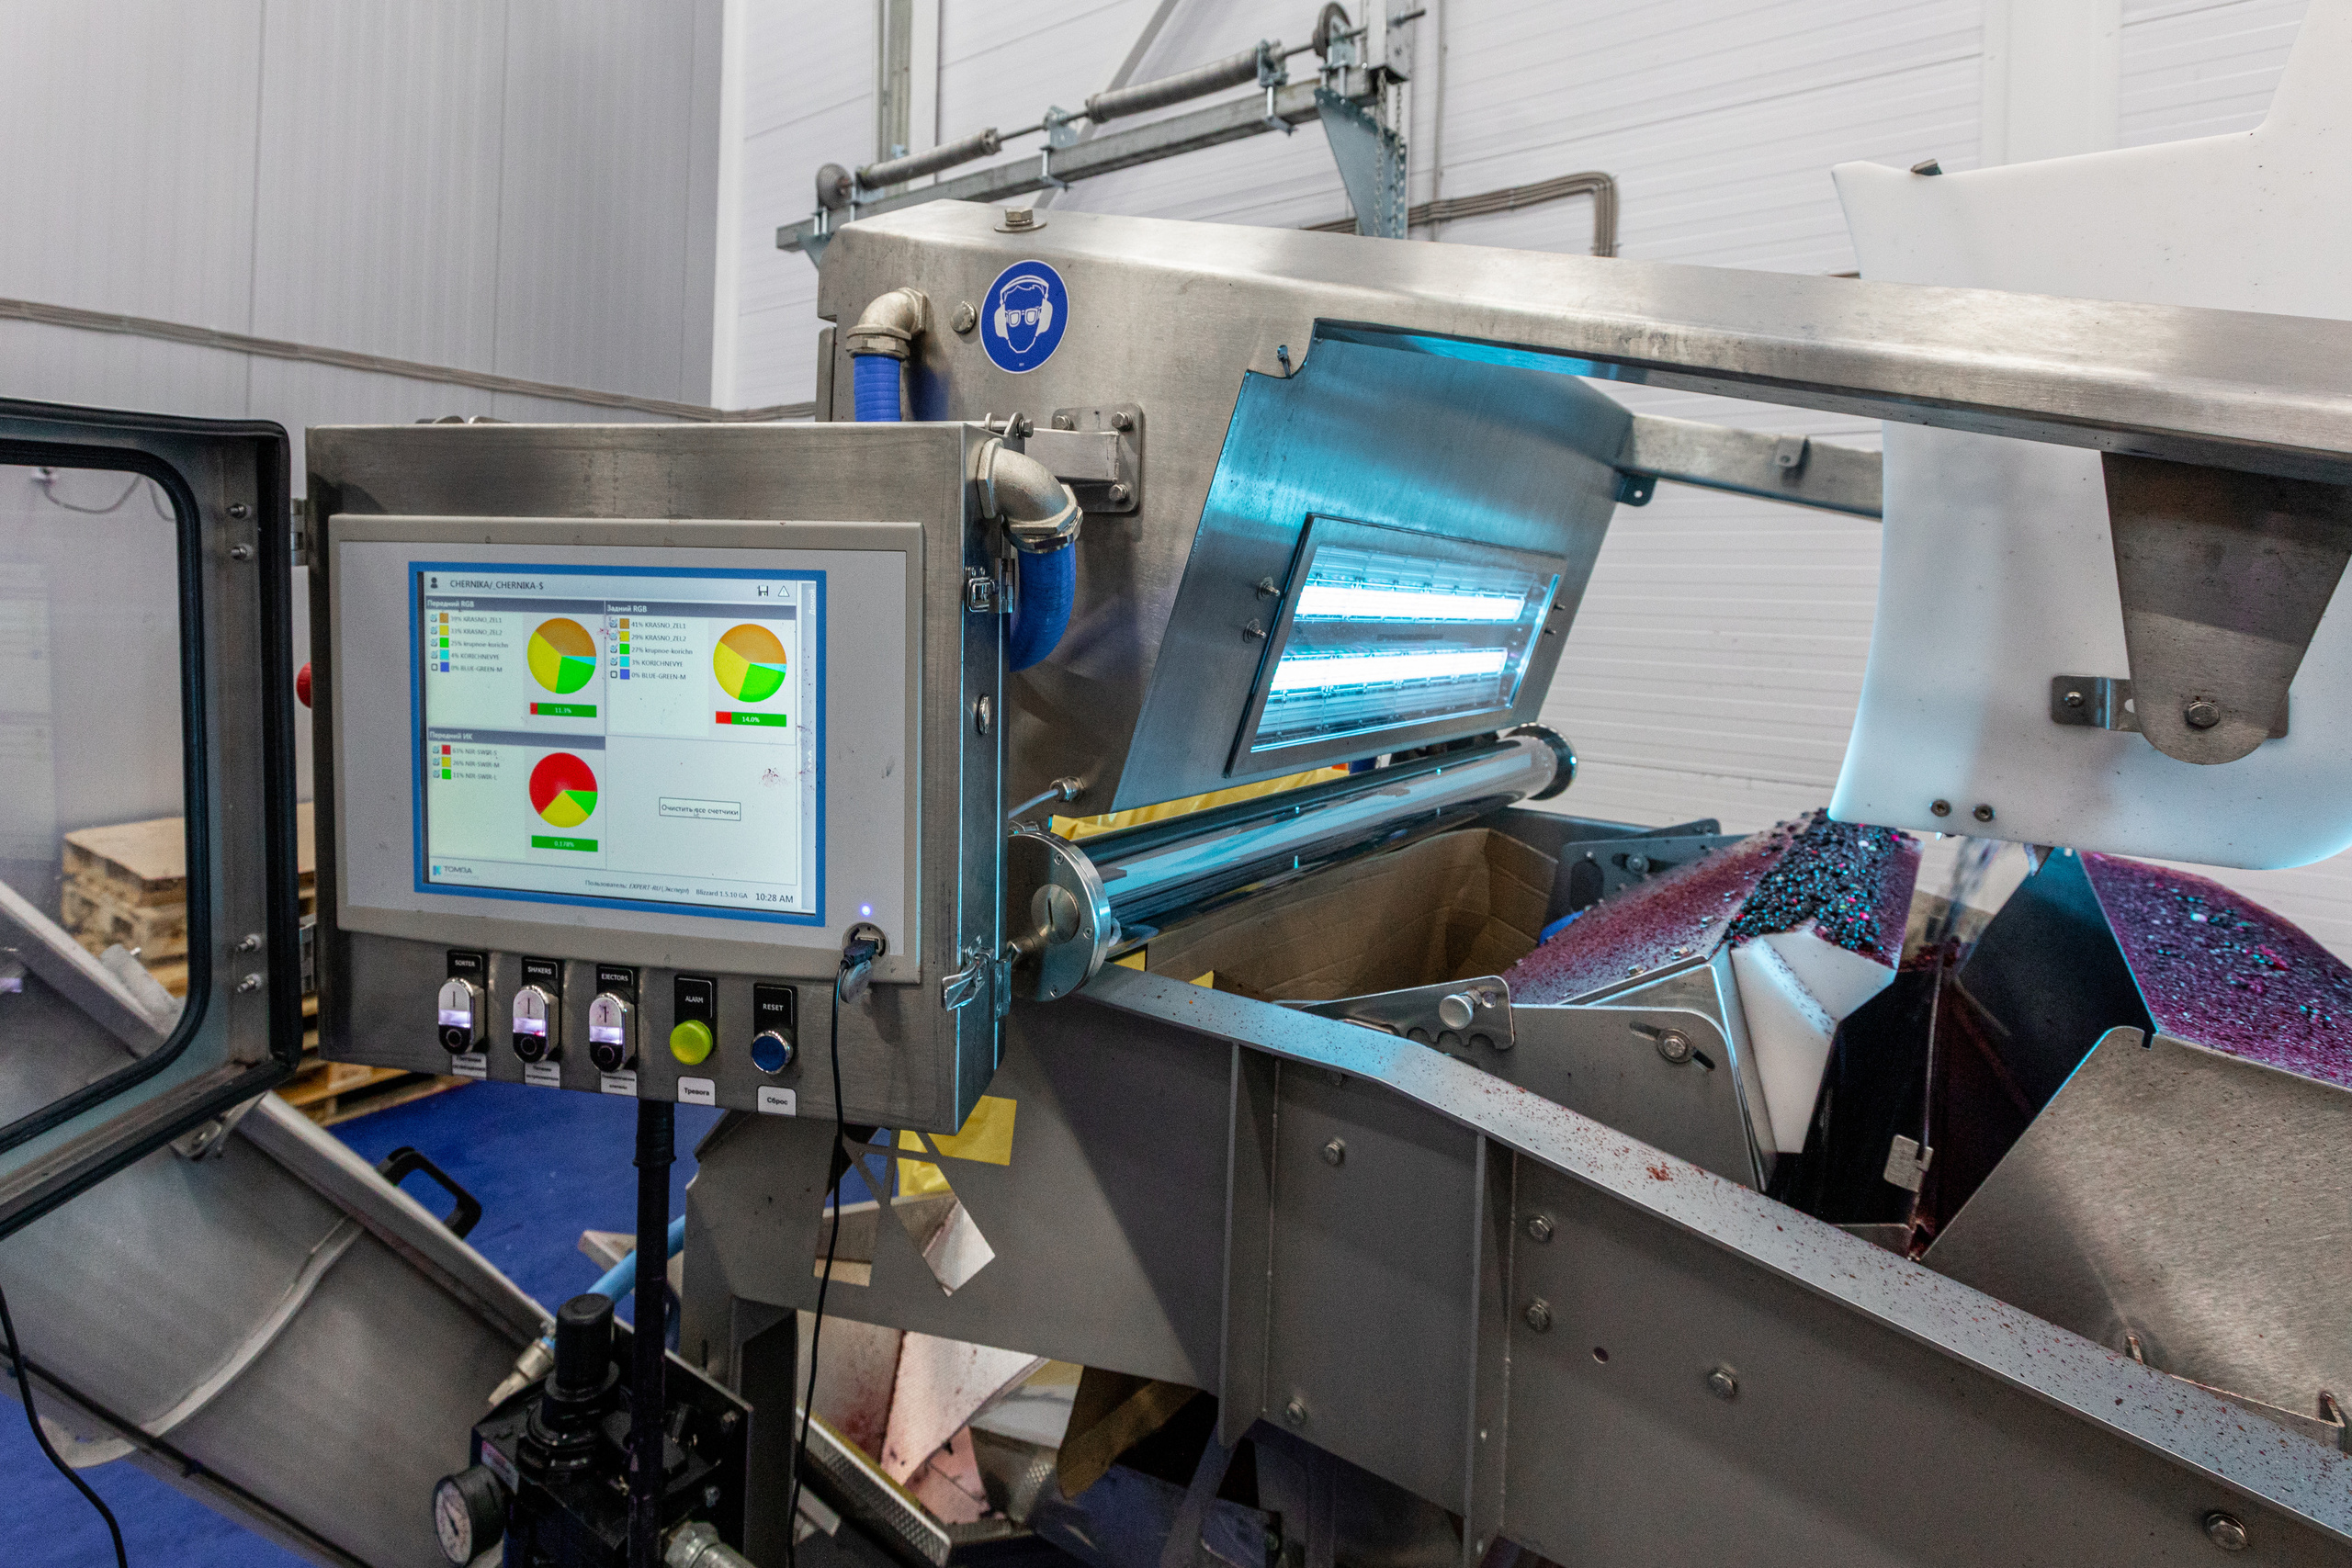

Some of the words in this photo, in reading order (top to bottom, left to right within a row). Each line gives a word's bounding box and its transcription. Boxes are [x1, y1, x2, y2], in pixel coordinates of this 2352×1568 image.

[606, 604, 631, 613] Задний
[662, 804, 693, 813] Очистить
[719, 890, 738, 898] 1.5.10
[755, 893, 777, 902] 10:28
[778, 895, 794, 903] AM
[601, 973, 628, 982] EJECTORS
[684, 995, 704, 1004] ALARM
[763, 1003, 784, 1011] RESET
[684, 1088, 710, 1097] Тревога
[766, 1097, 788, 1105] Сброс
